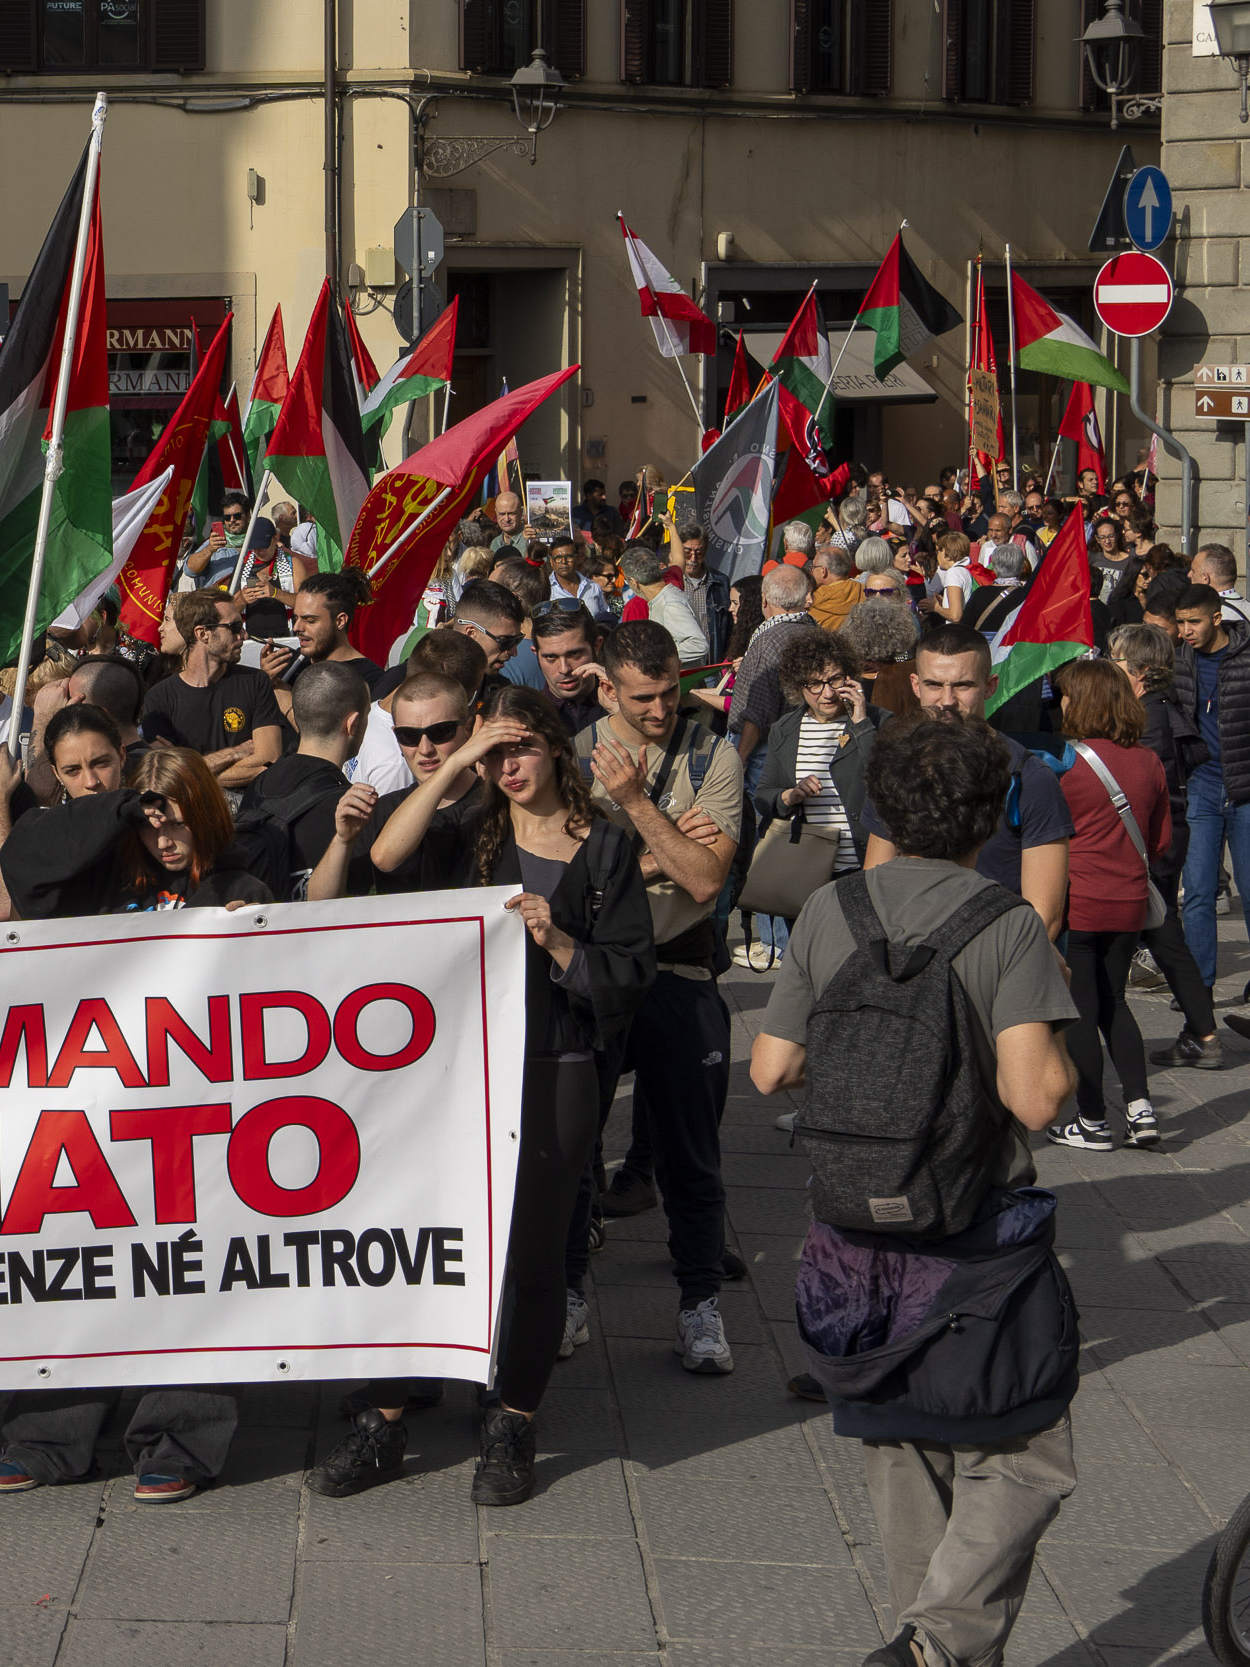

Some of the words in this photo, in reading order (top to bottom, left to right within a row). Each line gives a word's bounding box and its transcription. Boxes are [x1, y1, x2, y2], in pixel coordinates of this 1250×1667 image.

[1196, 32, 1216, 43] CA
[131, 1228, 207, 1298] NÉ
[218, 1226, 467, 1293] ALTROVE
